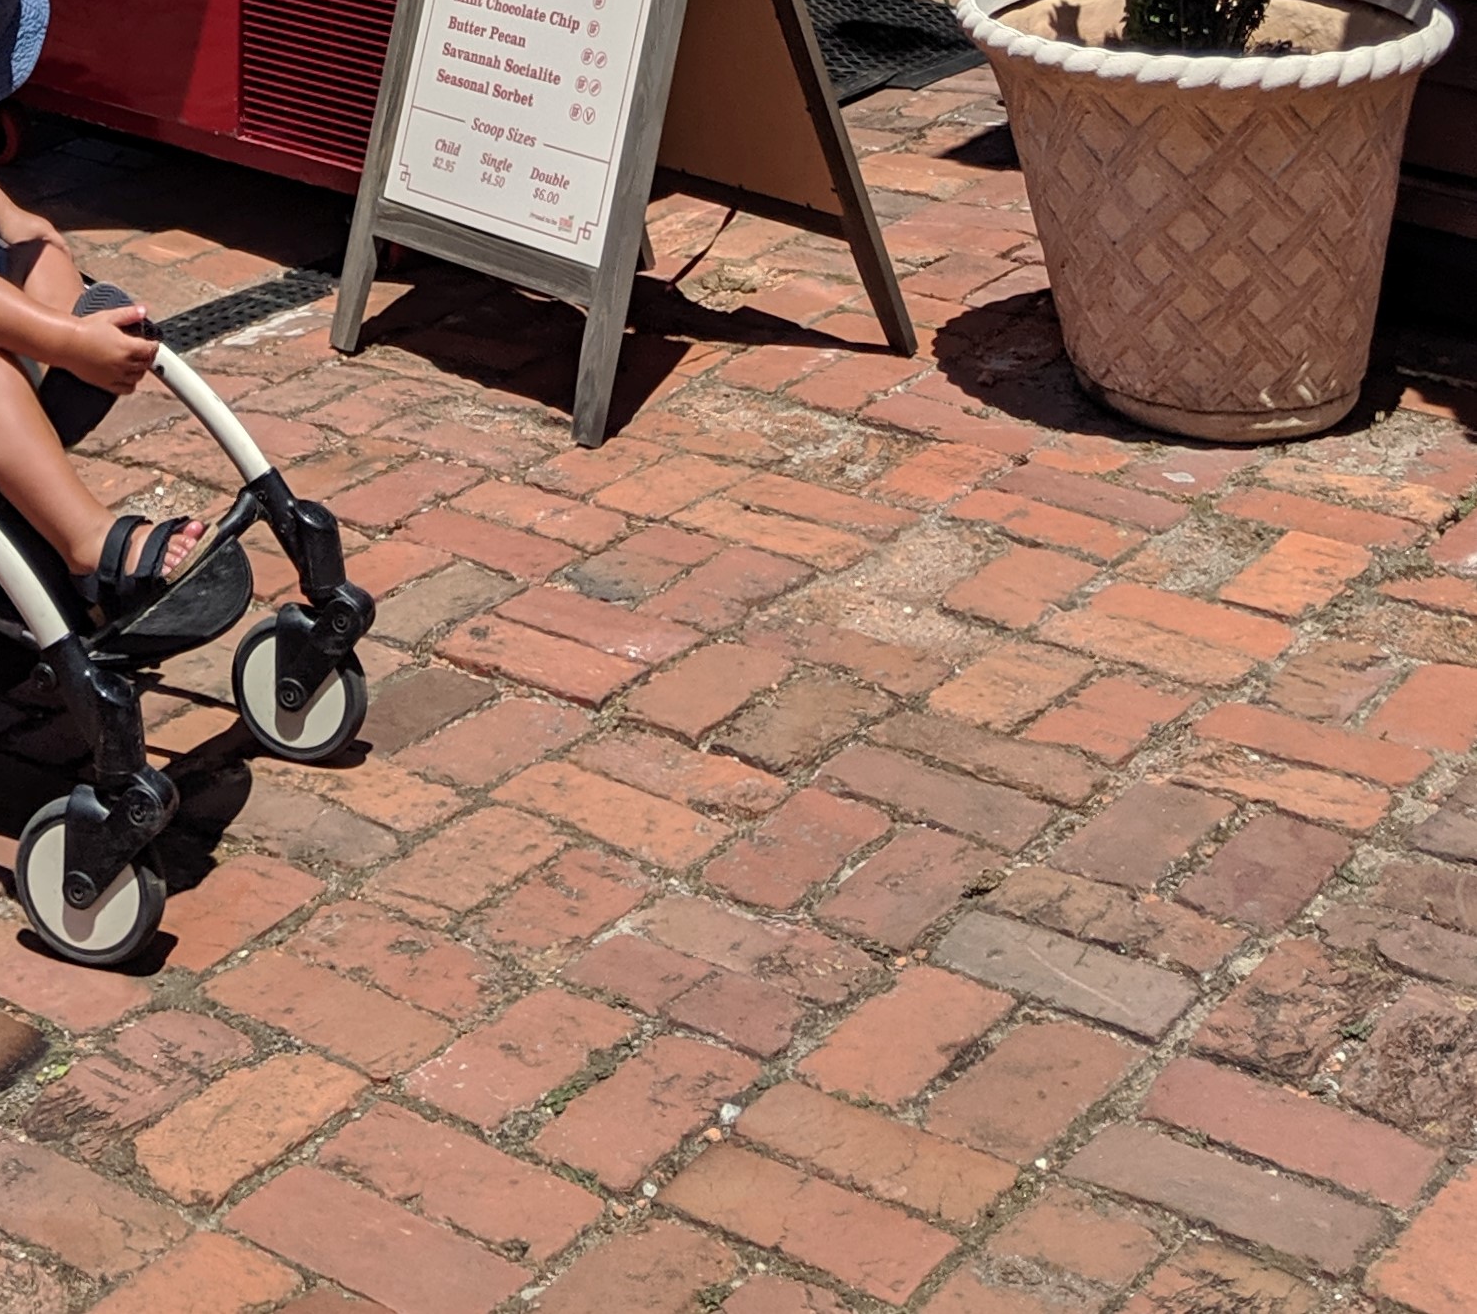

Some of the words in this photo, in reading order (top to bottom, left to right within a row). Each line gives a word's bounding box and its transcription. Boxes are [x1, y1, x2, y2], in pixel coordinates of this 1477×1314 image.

[447, 15, 487, 37] Butter
[488, 25, 527, 48] Pecan
[549, 11, 581, 34] Chip
[442, 41, 501, 71] Savannah
[504, 57, 562, 86] Socialite
[436, 68, 490, 95] Seasonal
[491, 83, 534, 107] Sorbet
[471, 117, 505, 142] Scoop
[506, 127, 538, 148] Sizes
[434, 138, 462, 157] Child
[432, 156, 456, 173] $2.95
[480, 152, 513, 174] Single
[480, 171, 506, 189] $4.50
[529, 167, 570, 190] Double
[532, 187, 560, 206] $6.00
